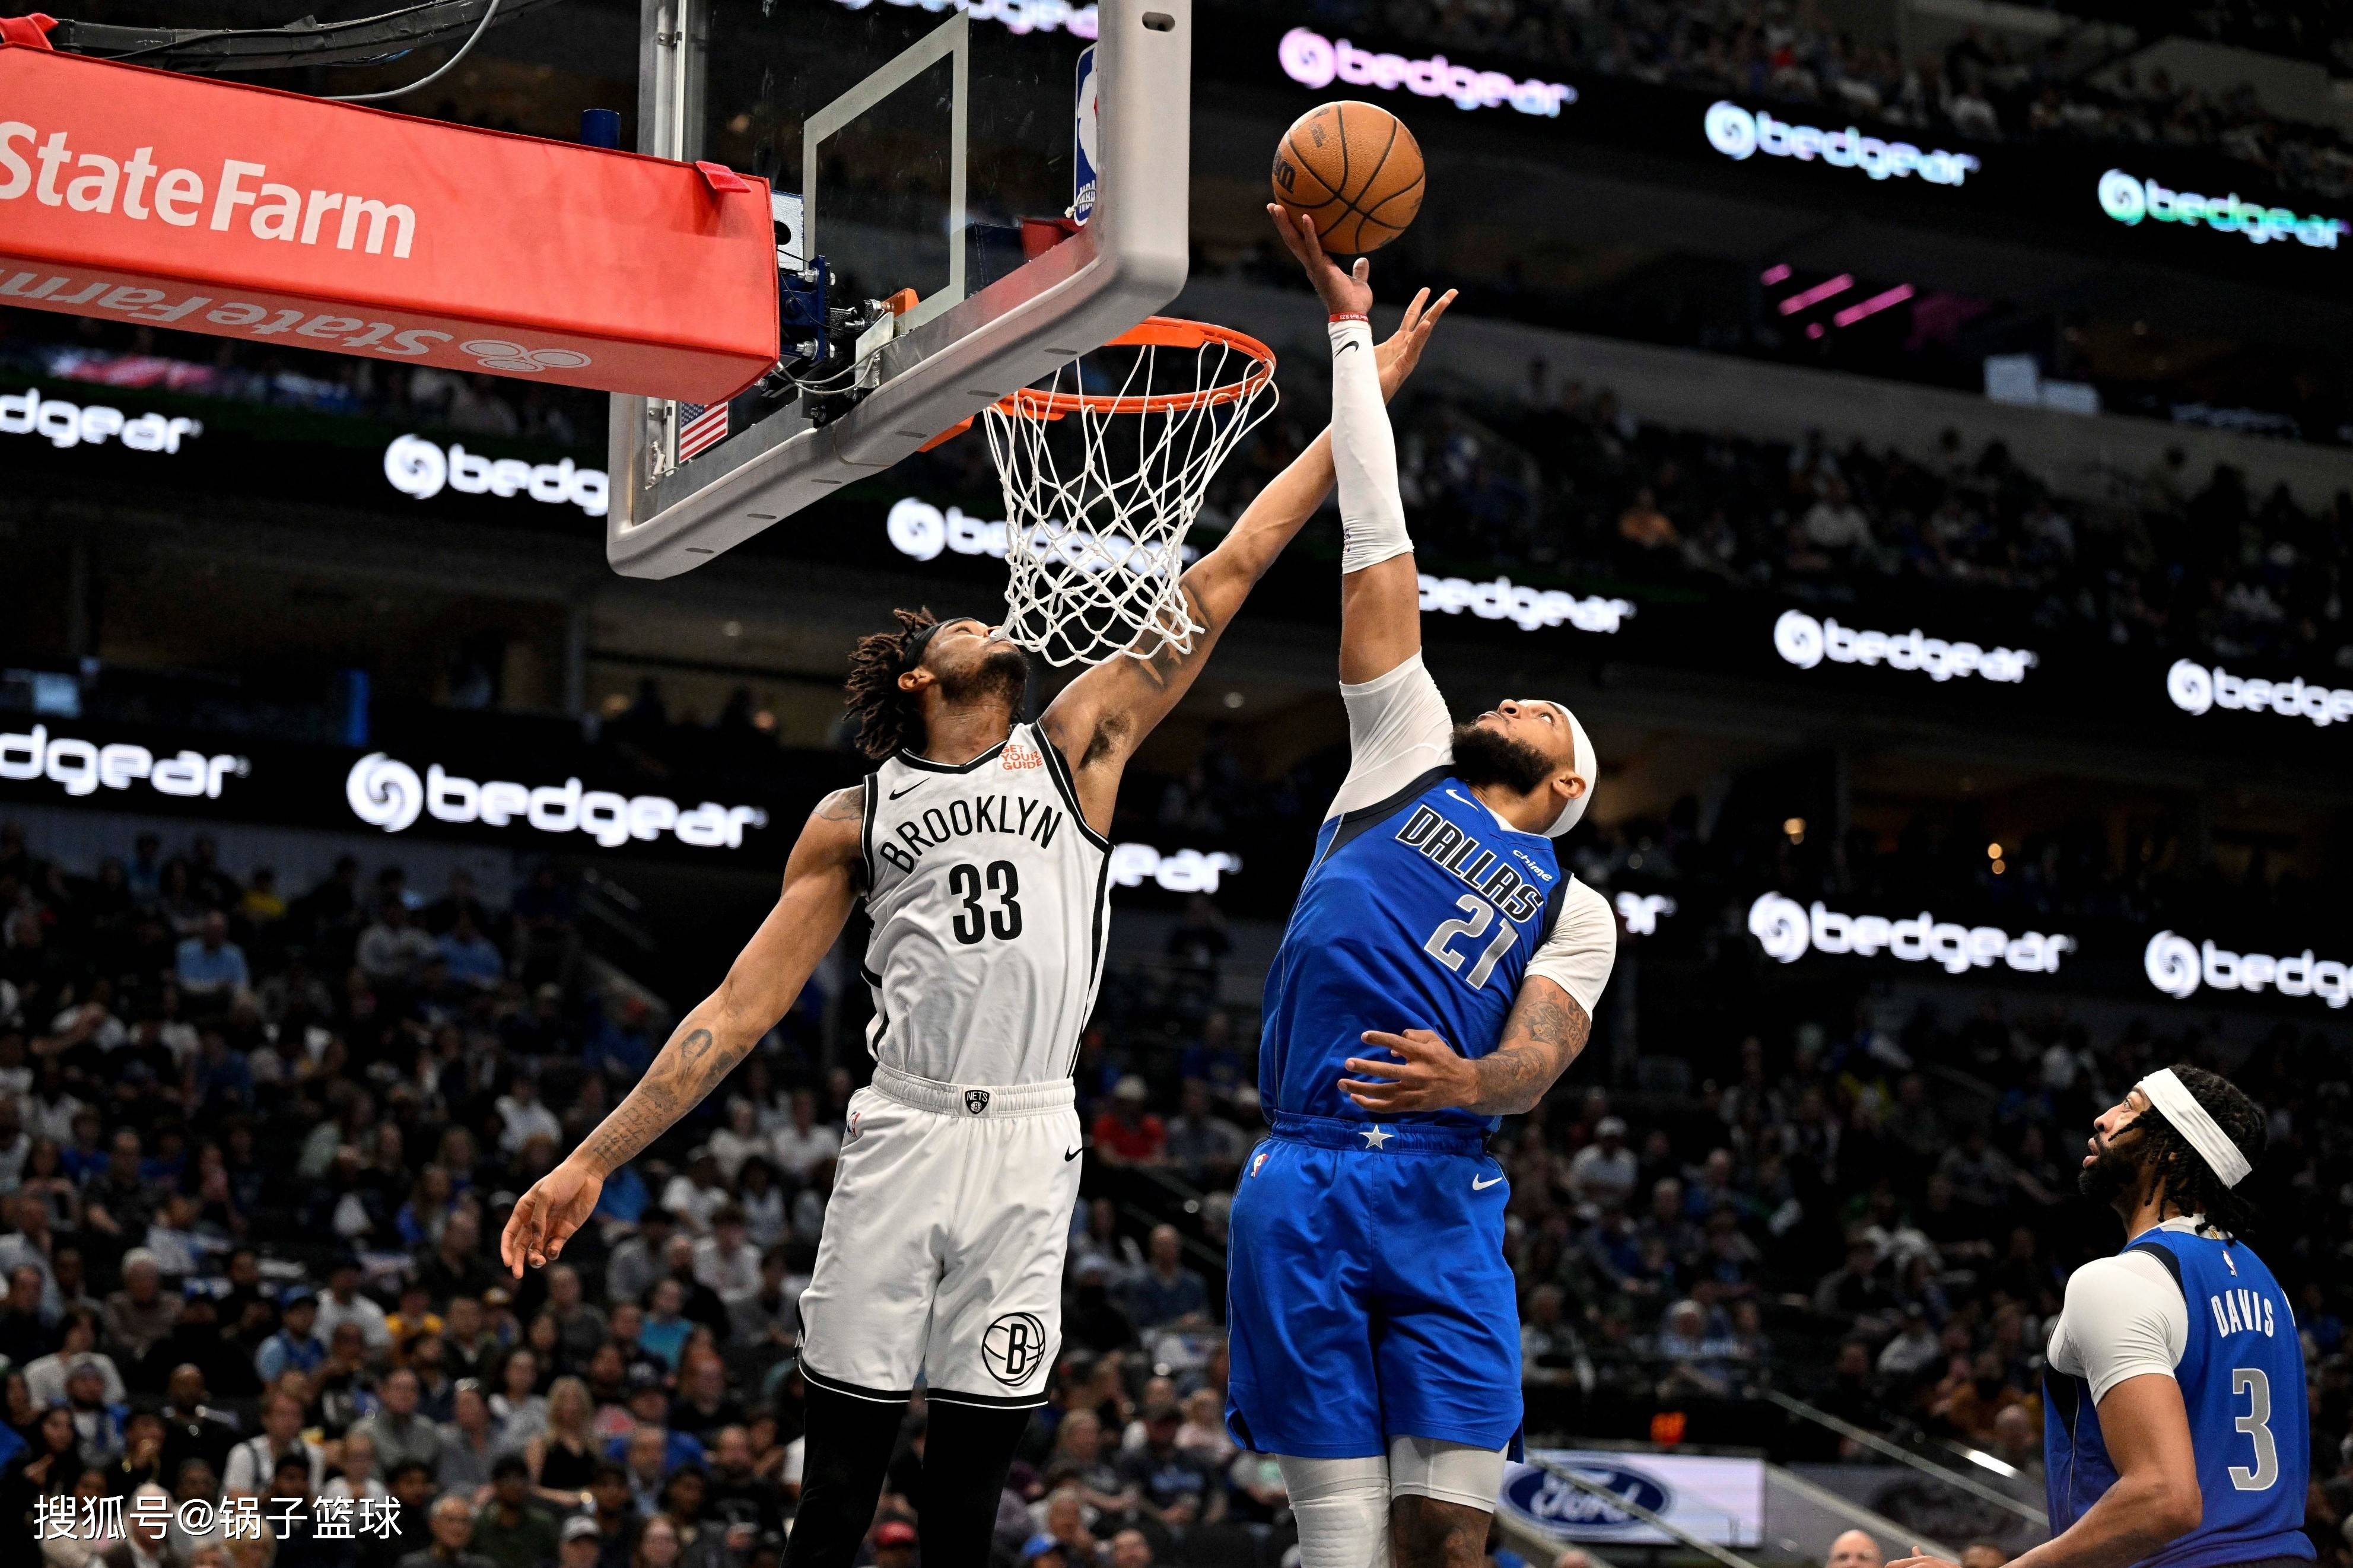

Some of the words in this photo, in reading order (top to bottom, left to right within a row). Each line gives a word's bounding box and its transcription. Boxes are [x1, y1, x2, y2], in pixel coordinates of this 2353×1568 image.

[1336, 39, 1566, 117] bedgear
[1757, 111, 1973, 186] bedgear
[0, 121, 204, 227] State
[210, 158, 417, 259] Farm
[2145, 179, 2344, 250] bedgear
[206, 302, 455, 356] State
[1824, 618, 2026, 682] bedgear
[1002, 757, 1043, 770] GUIDE
[426, 764, 752, 848] bedgear
[879, 794, 1063, 874] BROOKLYN
[1109, 842, 1231, 894] ear
[1395, 804, 1544, 923] DALLAS
[1513, 849, 1553, 882] chime
[949, 860, 1023, 945] 33
[1810, 901, 2065, 974] bedgear
[1424, 893, 1518, 991] 21
[2201, 939, 2353, 1009] bedg
[966, 1091, 988, 1102] NETS
[1006, 1322, 1028, 1375] B
[2211, 1289, 2273, 1338] DAVIS
[2228, 1367, 2279, 1491] 3
